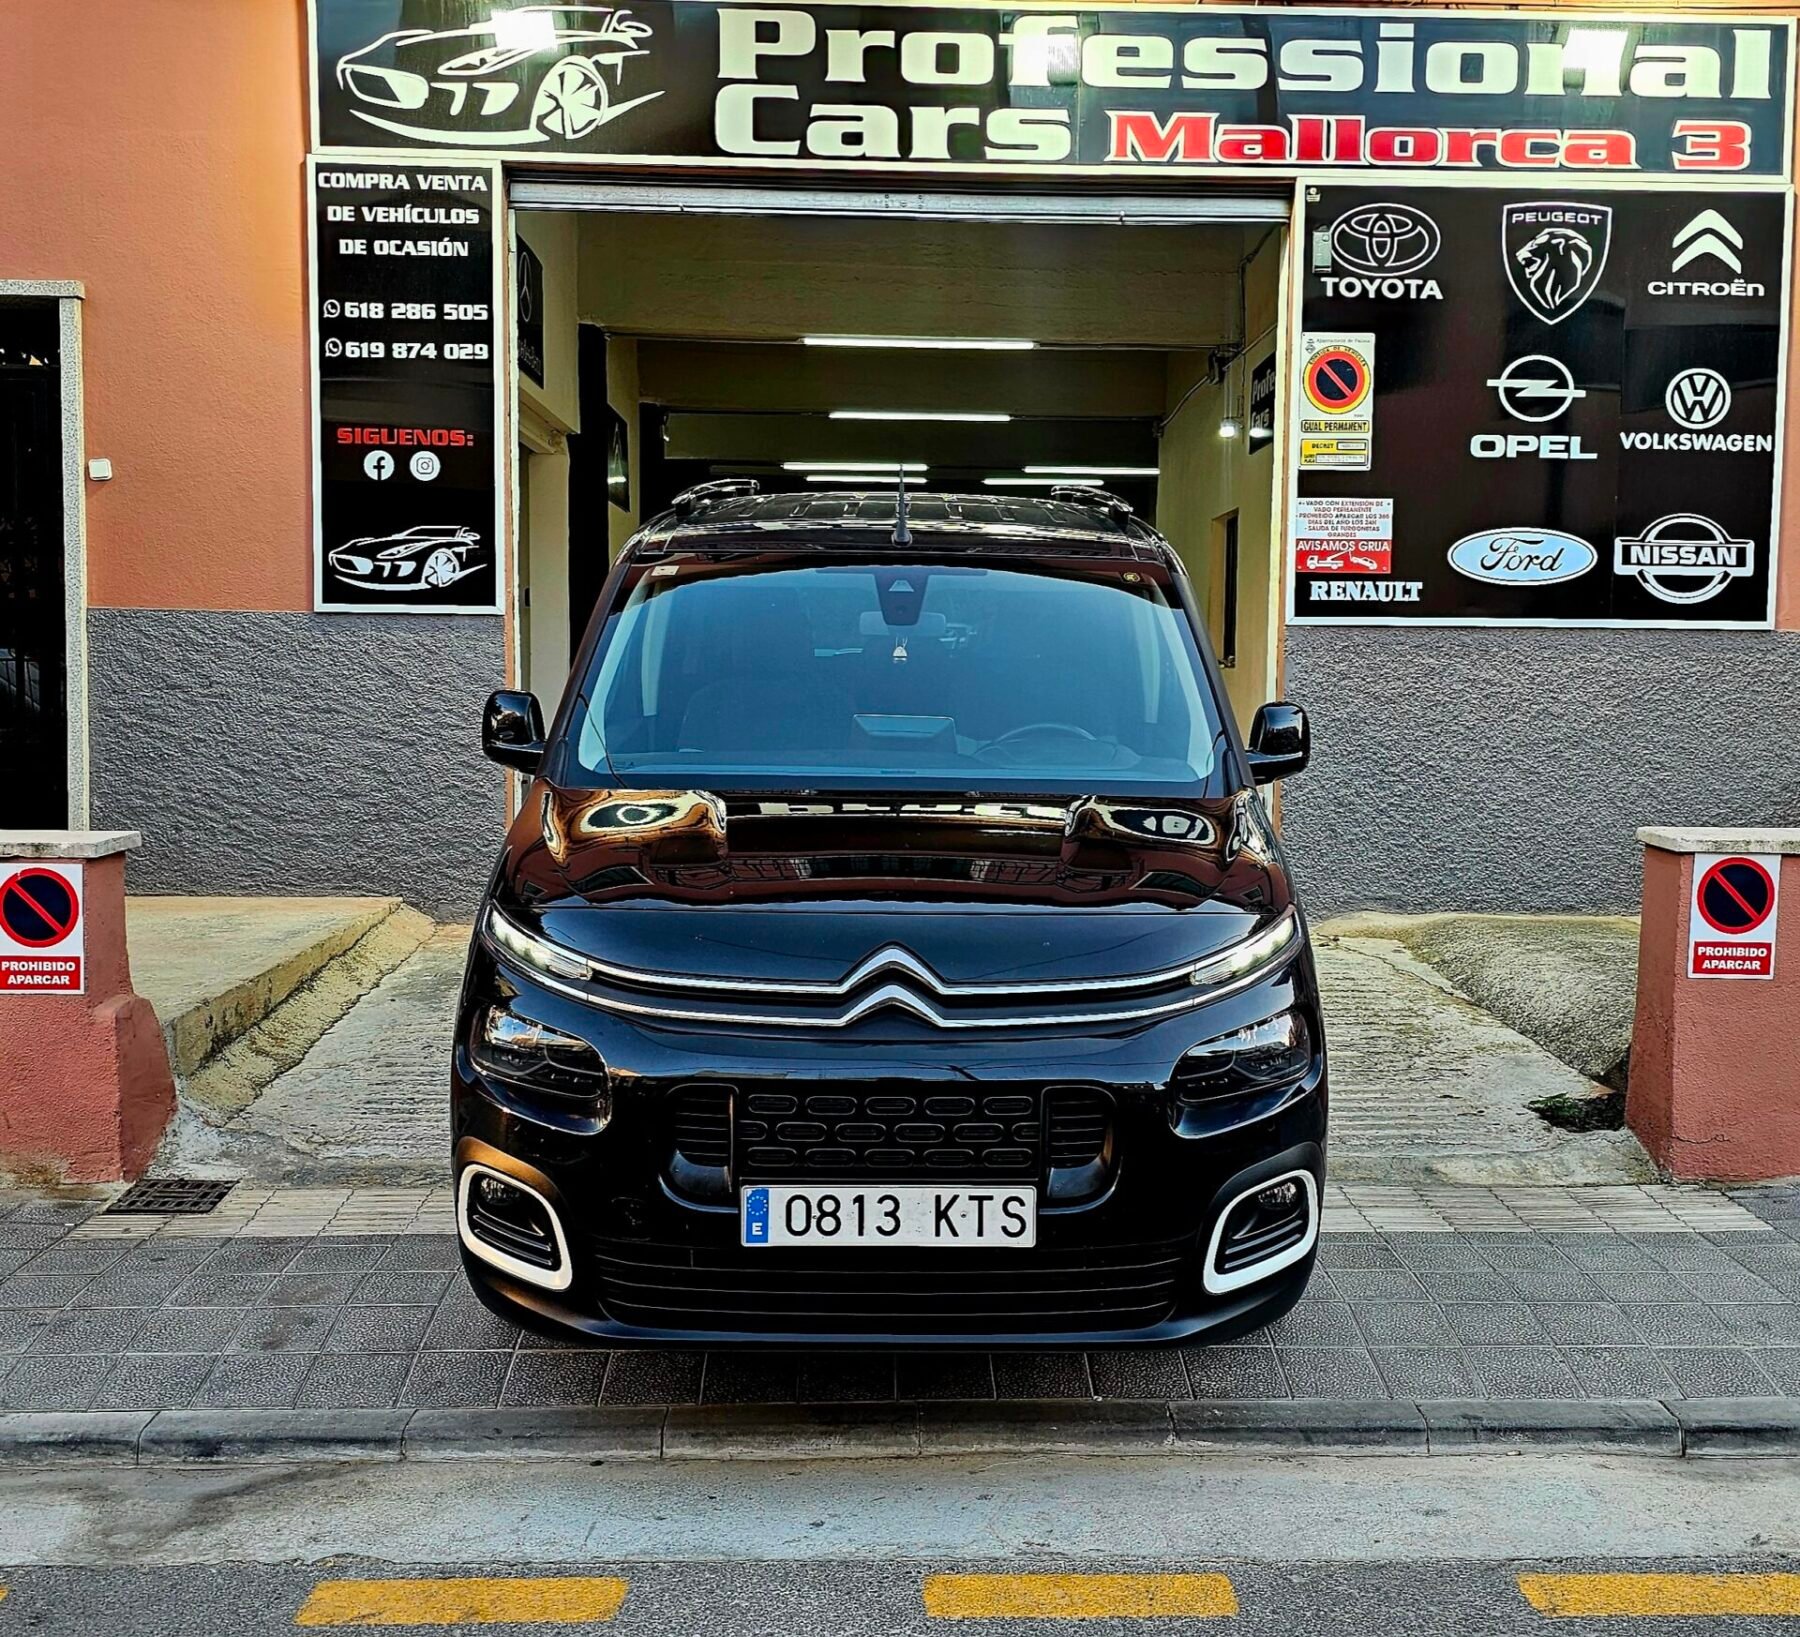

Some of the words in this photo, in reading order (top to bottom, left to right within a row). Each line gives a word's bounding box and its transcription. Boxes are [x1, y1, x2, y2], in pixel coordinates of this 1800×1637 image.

[717, 8, 1771, 98] Professional
[714, 83, 1072, 160] Cars
[1104, 108, 1641, 169] Mallorca
[1671, 117, 1755, 170] 3
[318, 172, 410, 190] COMPRA
[416, 174, 488, 191] VENTA
[327, 205, 355, 222] DE
[361, 204, 480, 224] VEHÍCULOS
[1511, 211, 1602, 225] PEUGEOT
[339, 239, 367, 255] DE
[373, 237, 469, 256] OCASIÓN
[1320, 276, 1443, 299] TOYOTA
[344, 302, 384, 319] 618
[391, 302, 436, 320] 286
[443, 303, 488, 320] 505
[345, 341, 385, 358] 619
[392, 342, 437, 359] 874
[443, 343, 489, 360] 029
[1303, 421, 1322, 431] GUAL
[1324, 421, 1367, 431] PERMANENT
[337, 427, 474, 446] SIGUENOS:
[1620, 431, 1773, 452] VOLKSWAGEN
[1470, 434, 1598, 460] OPEL
[1296, 540, 1356, 551] AVISAMOS
[1358, 541, 1390, 552] GRUA
[1480, 537, 1564, 572] Ford
[1630, 545, 1737, 566] NISSAN
[1309, 581, 1423, 602] RENAULT
[1697, 946, 1768, 957] PROHIBIDO
[1, 960, 76, 972] PROHIBIDO
[1702, 960, 1761, 970] APARCAR
[7, 975, 70, 985] APARCAR
[784, 1193, 901, 1237] 0813
[934, 1193, 1027, 1239] KTS
[751, 1222, 763, 1235] E
